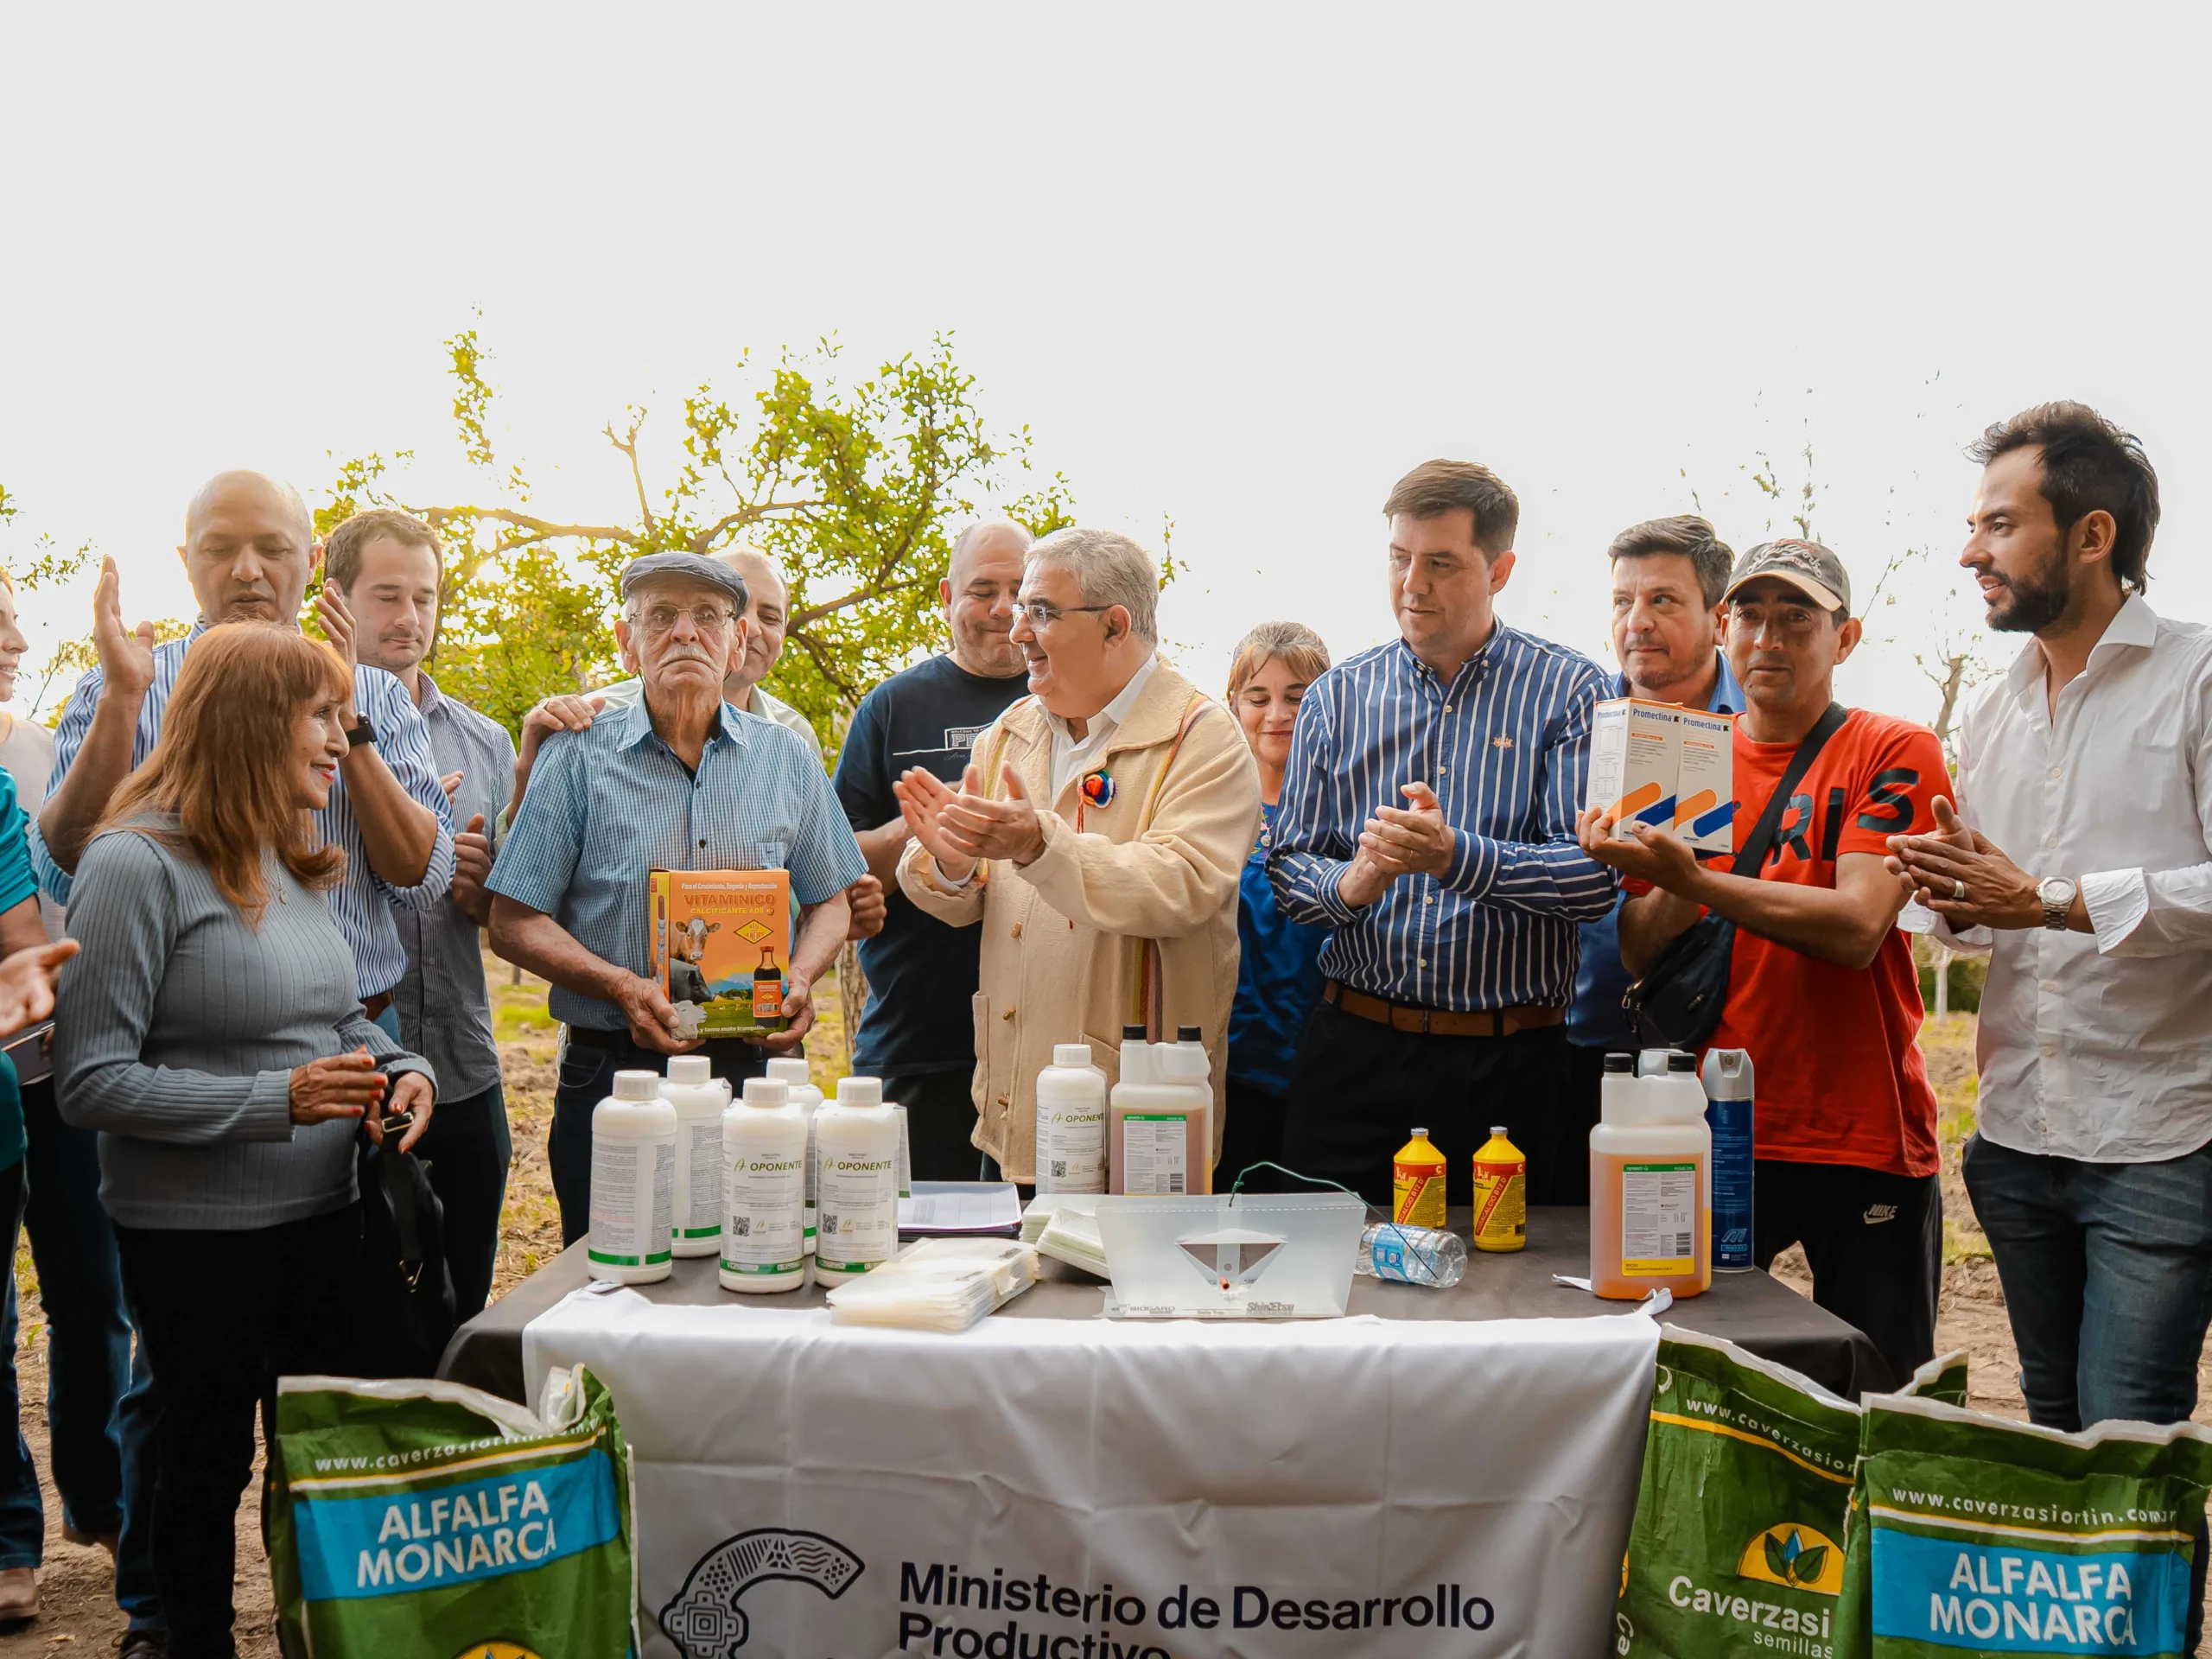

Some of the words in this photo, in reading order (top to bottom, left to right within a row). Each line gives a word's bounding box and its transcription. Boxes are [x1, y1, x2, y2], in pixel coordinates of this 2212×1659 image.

[1633, 708, 1672, 722] Promectina
[1683, 717, 1721, 732] Promectina
[683, 893, 777, 906] VITAMINICO
[749, 1160, 803, 1172] OPONENTE
[837, 1160, 892, 1172] OPONENTE
[1398, 1196, 1414, 1224] ACALCIO
[1868, 1204, 1897, 1219] NIKE
[378, 1480, 550, 1544] ALFALFA
[356, 1518, 557, 1589] MONARCA
[1949, 1553, 2132, 1601] ALFALFA
[899, 1560, 1147, 1626] Ministerio
[1157, 1584, 1221, 1629] de
[1232, 1583, 1495, 1630] Desarrollo
[1669, 1575, 1830, 1638] Caverzasi
[1929, 1592, 2137, 1647] MONARCA
[1752, 1630, 1834, 1659] semillas
